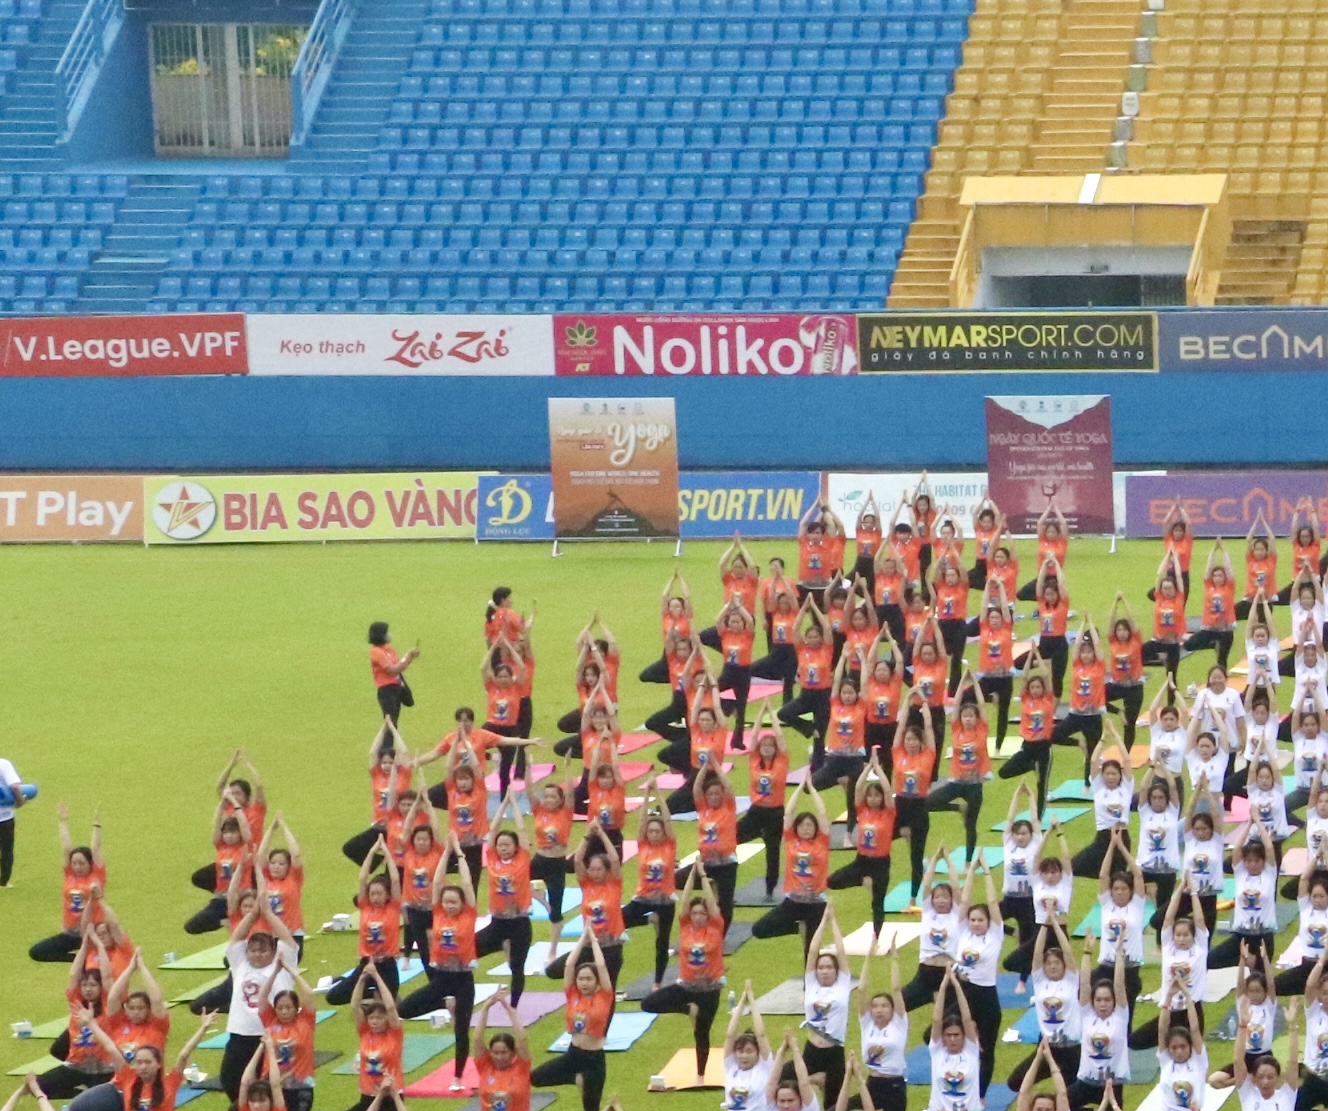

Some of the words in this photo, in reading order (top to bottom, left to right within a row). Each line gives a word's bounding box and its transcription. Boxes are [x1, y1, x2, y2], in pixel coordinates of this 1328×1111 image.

[280, 340, 313, 356] Kẹo
[318, 340, 365, 356] thạch
[869, 324, 1144, 348] NEYMARSPORT.COM
[13, 331, 241, 368] V.League.VPF
[613, 324, 804, 375] Noliko
[965, 350, 1013, 360] banh
[1076, 432, 1108, 444] YOGA
[934, 484, 977, 497] HABITAT
[37, 490, 134, 536] Play
[223, 492, 288, 531] BIA
[297, 490, 376, 531] SAO
